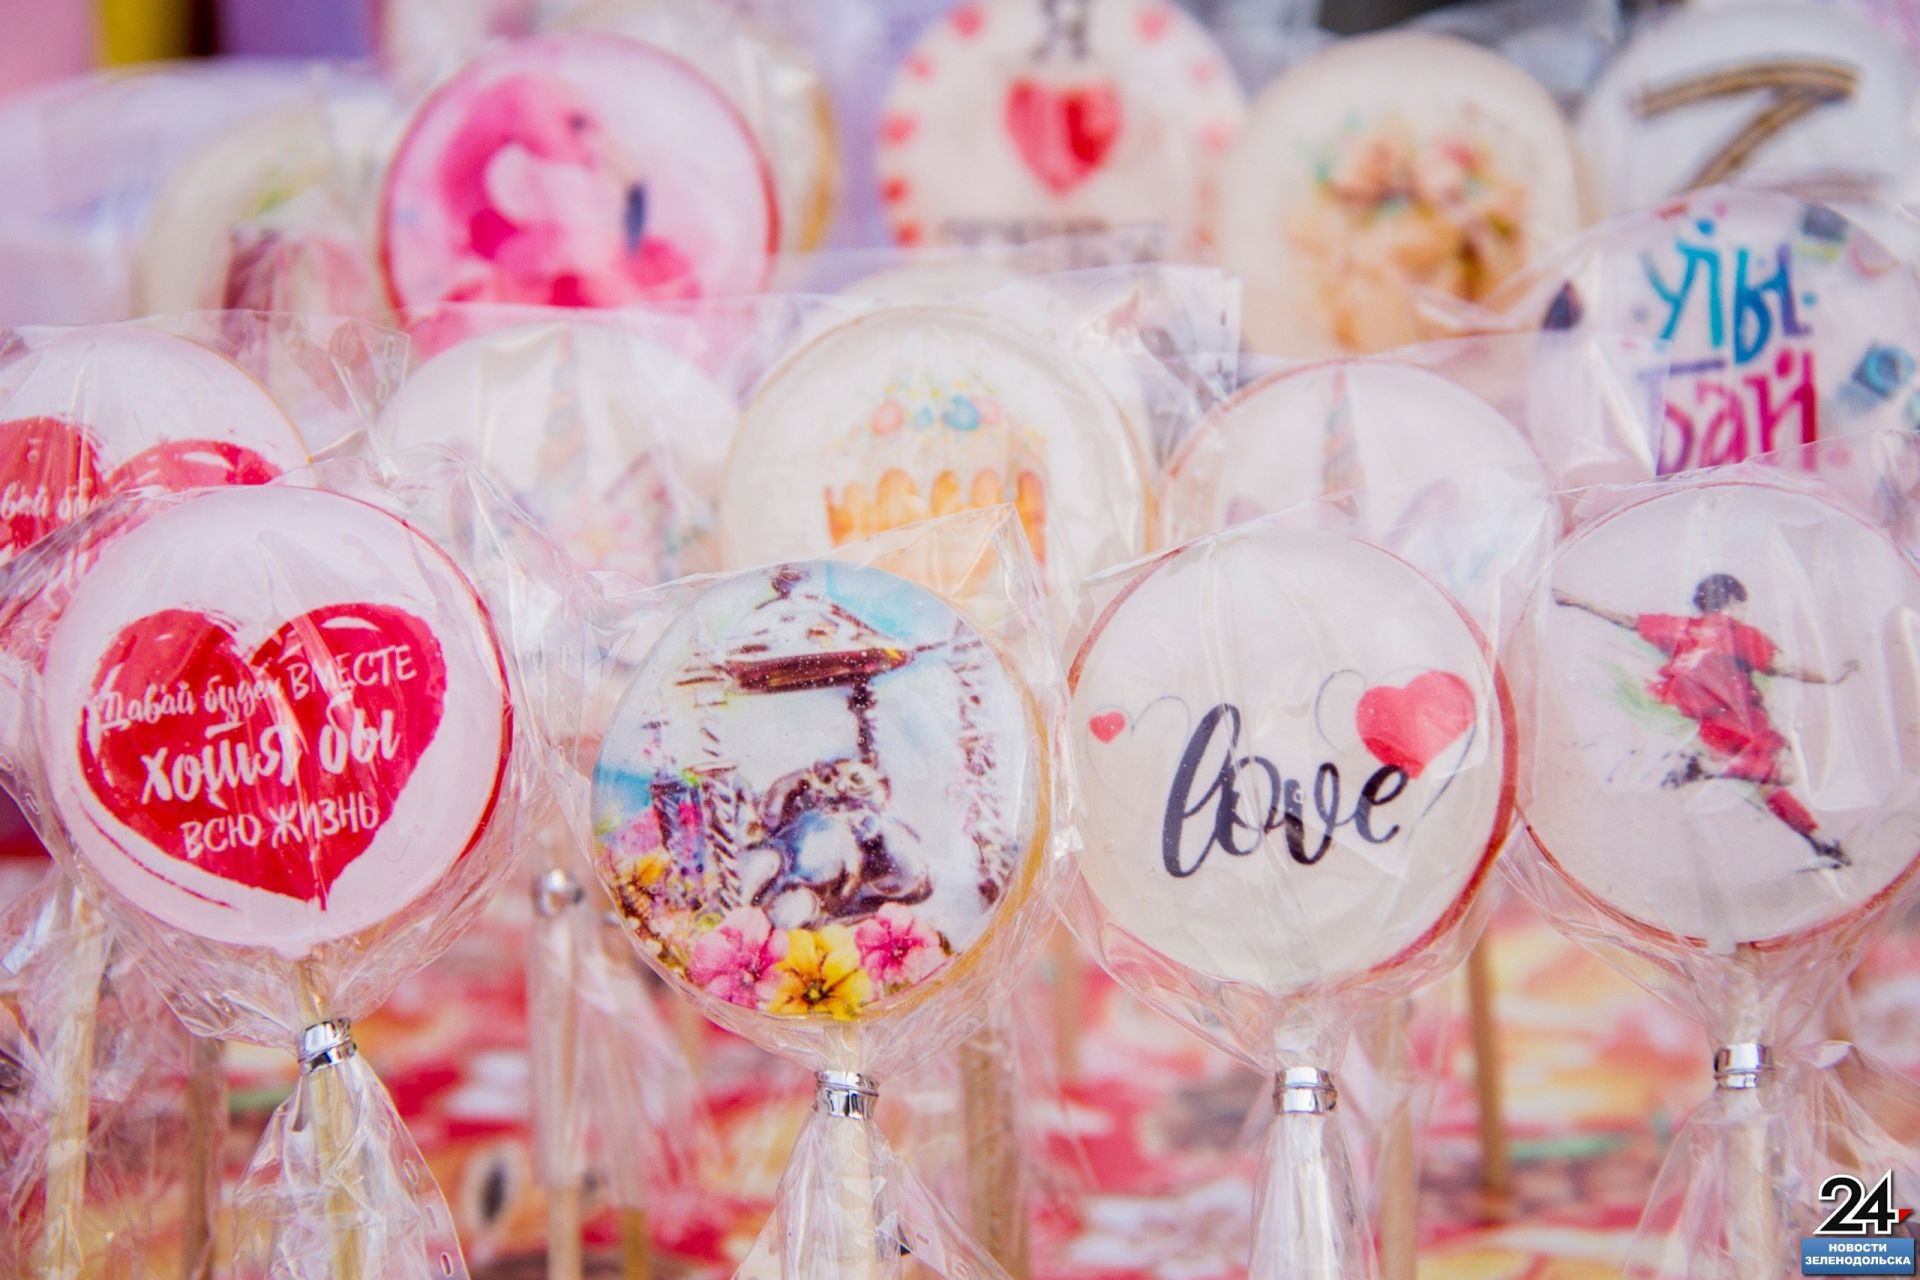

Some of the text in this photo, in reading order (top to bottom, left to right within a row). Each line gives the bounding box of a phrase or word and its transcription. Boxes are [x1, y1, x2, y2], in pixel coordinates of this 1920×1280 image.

[318, 690, 400, 775] бы
[179, 791, 379, 859] ВСЮ ЖИЗНЬ
[1162, 703, 1409, 878] love
